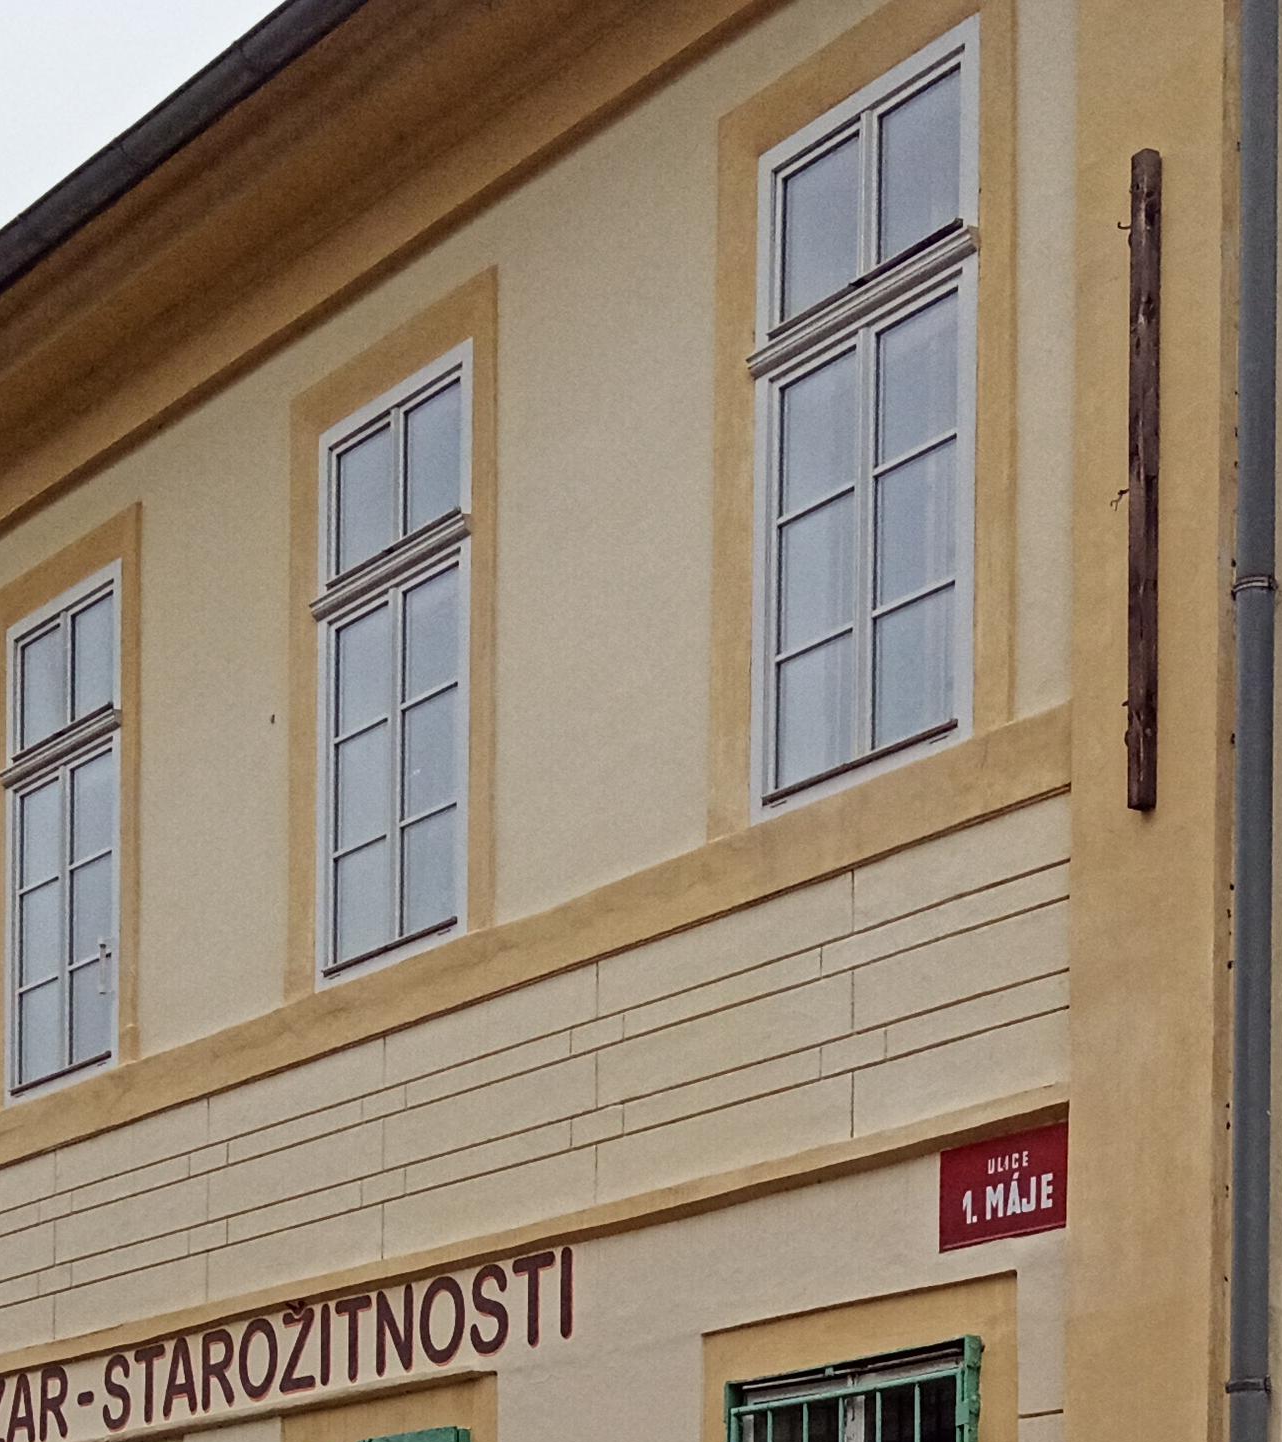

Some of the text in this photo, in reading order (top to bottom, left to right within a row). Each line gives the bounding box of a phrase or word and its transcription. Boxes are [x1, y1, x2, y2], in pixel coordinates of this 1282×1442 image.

[987, 1151, 1029, 1175] ULICE
[962, 1172, 1053, 1225] 1. MÁJE
